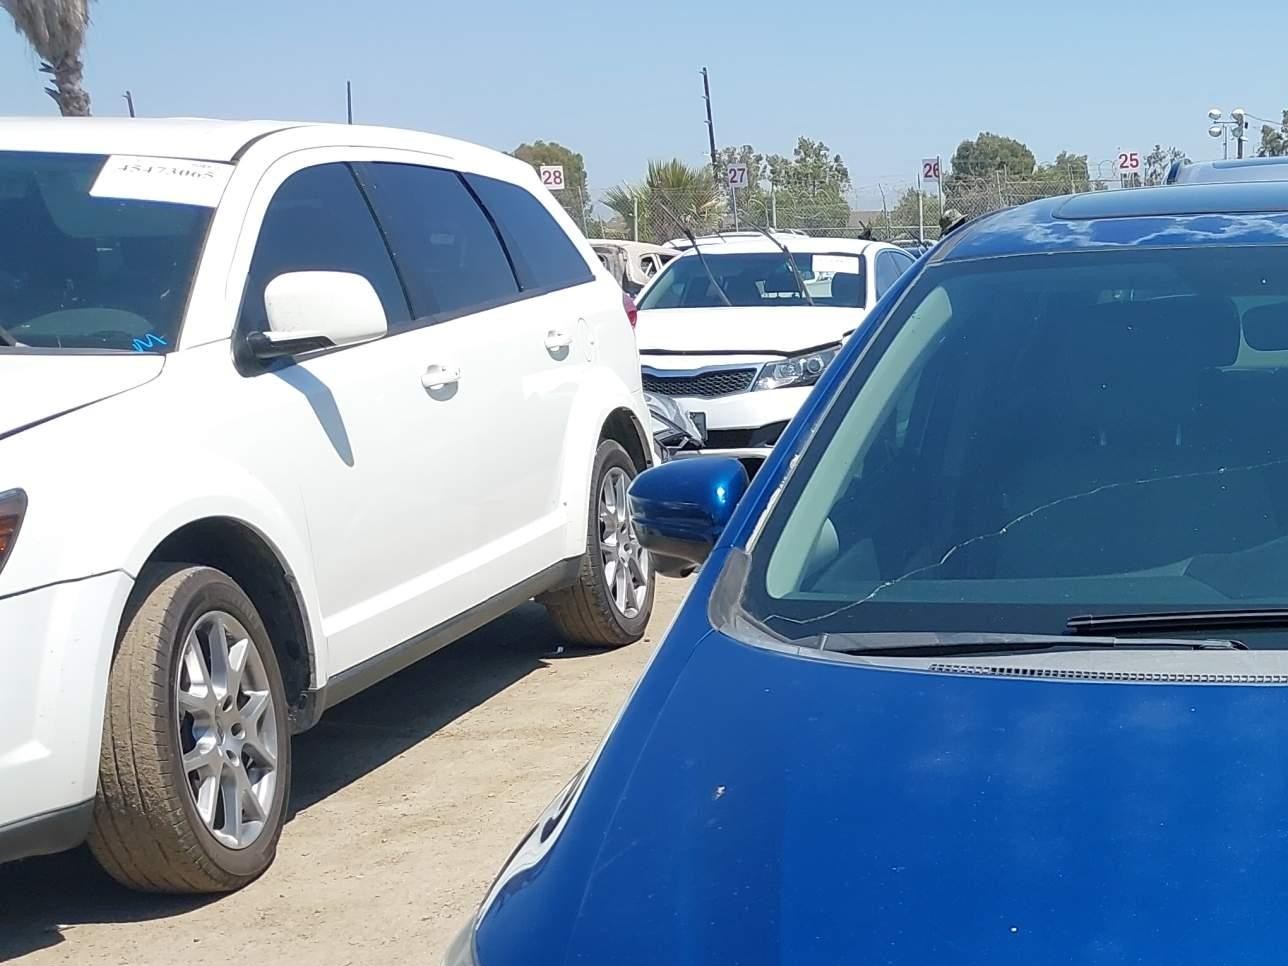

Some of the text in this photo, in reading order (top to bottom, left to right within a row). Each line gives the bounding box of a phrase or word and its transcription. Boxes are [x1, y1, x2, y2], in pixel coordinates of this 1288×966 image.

[1119, 153, 1139, 168] 25
[542, 170, 562, 185] 28
[729, 168, 746, 183] 27
[923, 162, 939, 178] 26
